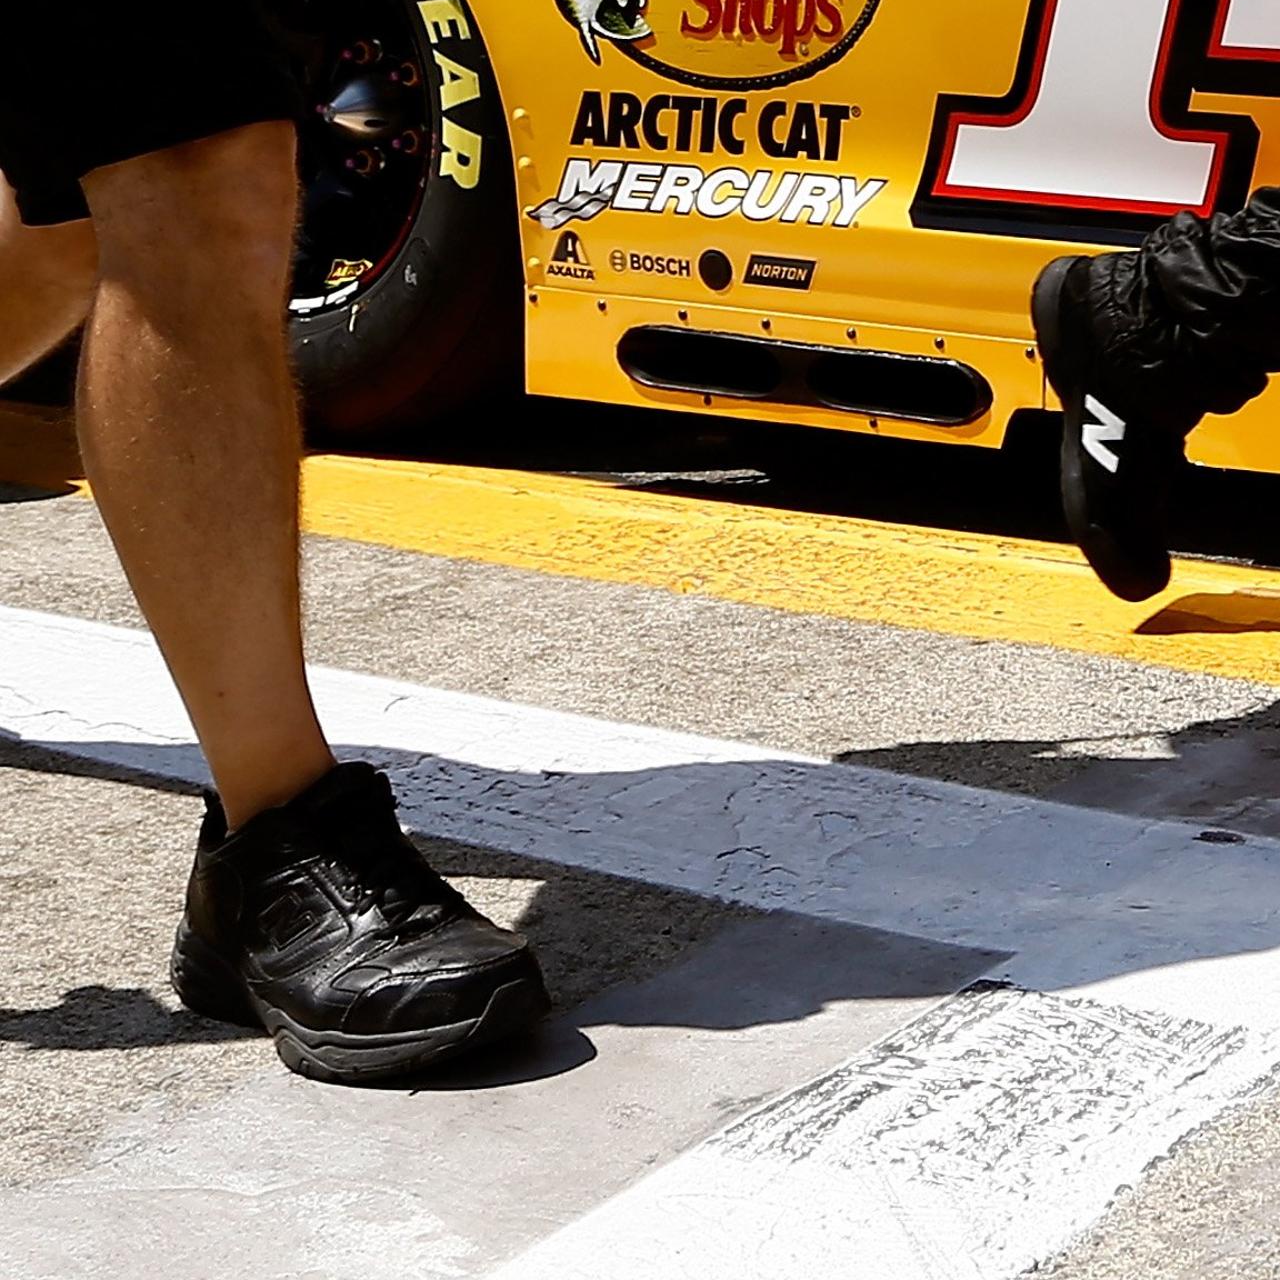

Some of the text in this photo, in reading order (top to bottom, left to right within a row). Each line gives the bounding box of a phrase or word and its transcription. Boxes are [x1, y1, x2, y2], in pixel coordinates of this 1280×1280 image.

[569, 91, 851, 162] ARCTIC CAT
[556, 158, 890, 228] MERCURY
[546, 265, 596, 281] AXALTA
[629, 252, 691, 278] BOSCH
[751, 262, 809, 282] NORTON
[1083, 393, 1126, 472] N
